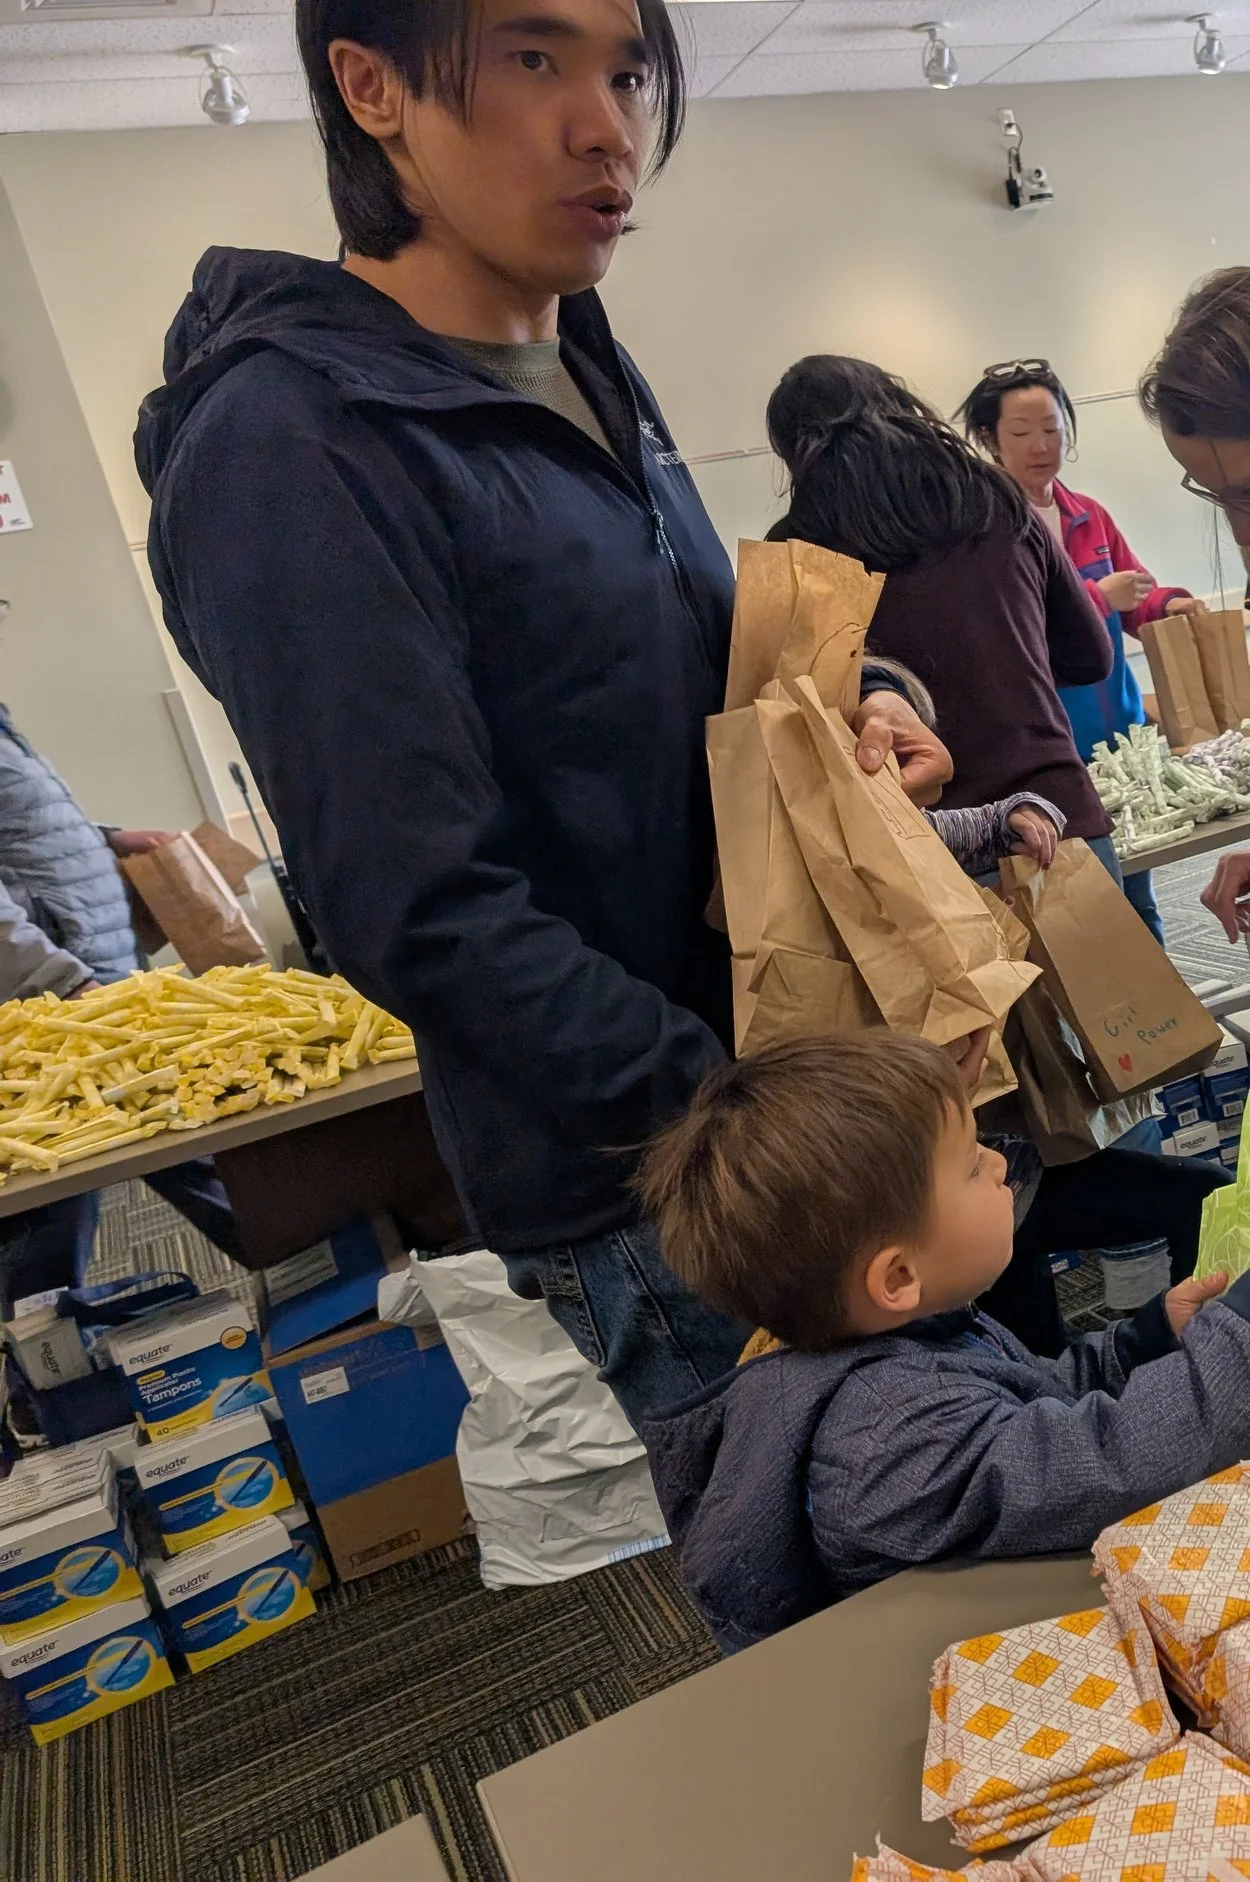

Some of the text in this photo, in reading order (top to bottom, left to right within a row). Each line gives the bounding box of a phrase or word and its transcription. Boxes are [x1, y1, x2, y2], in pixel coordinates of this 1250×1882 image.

[1104, 1006, 1137, 1037] Girl
[1179, 1135, 1207, 1149] equate
[41, 1342, 61, 1374] equate
[128, 1344, 172, 1366] equate
[138, 1377, 172, 1391] Premium
[140, 1379, 178, 1396] Applicator
[142, 1378, 202, 1404] Tampons
[156, 1427, 170, 1437] 40
[146, 1456, 188, 1479] equate
[0, 1548, 22, 1563] ate
[168, 1571, 210, 1597] equate
[11, 1641, 57, 1667] equate
